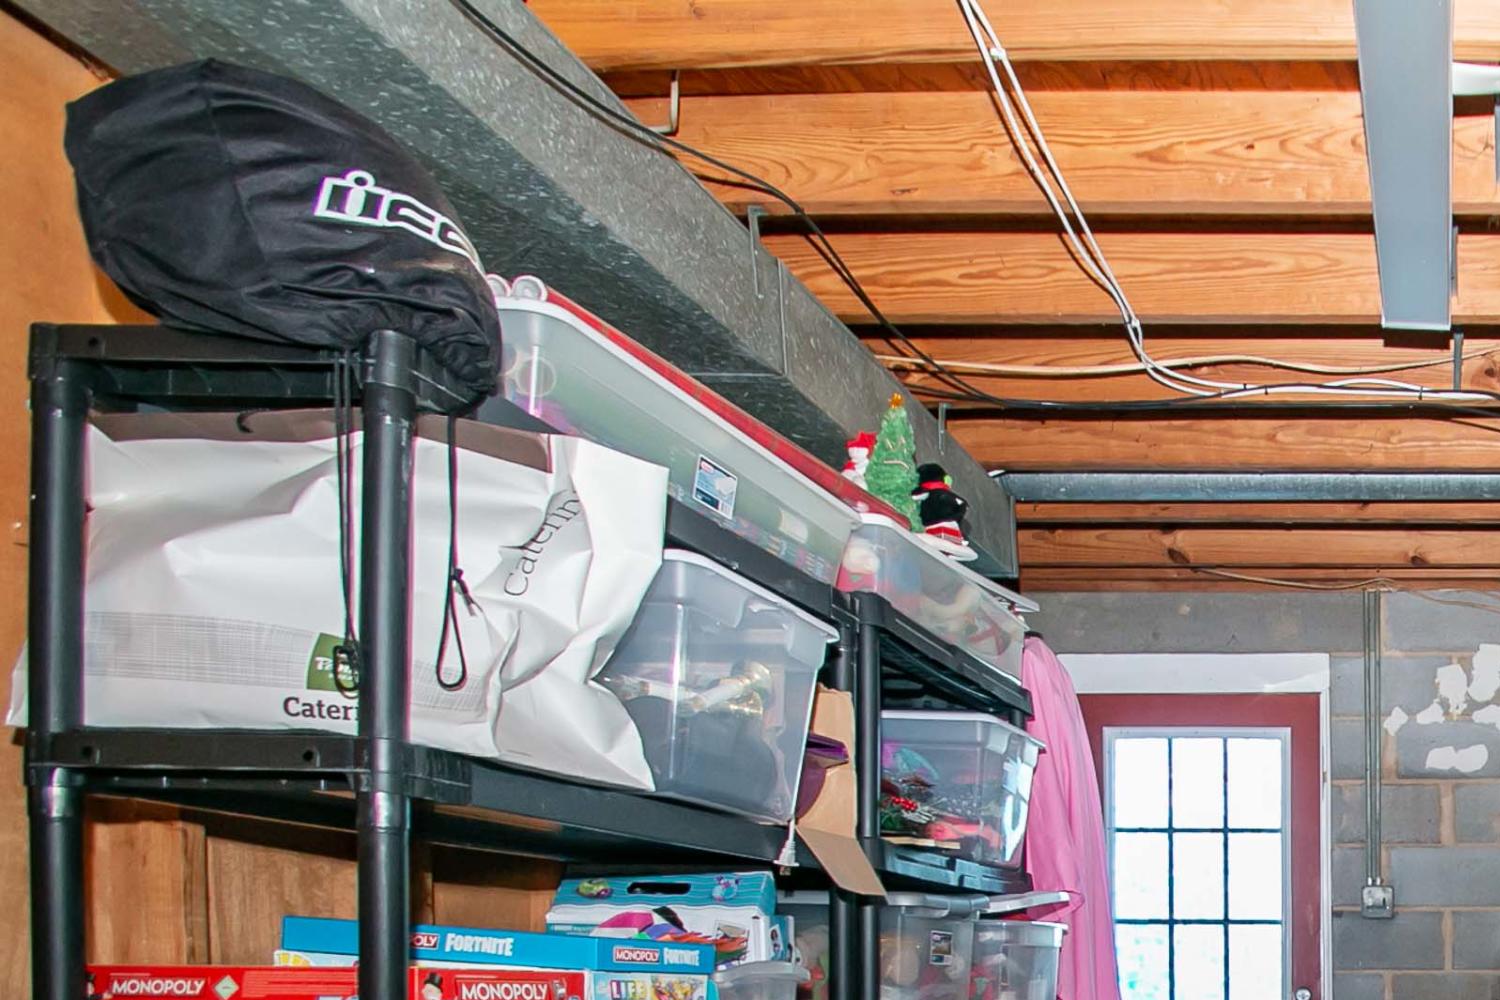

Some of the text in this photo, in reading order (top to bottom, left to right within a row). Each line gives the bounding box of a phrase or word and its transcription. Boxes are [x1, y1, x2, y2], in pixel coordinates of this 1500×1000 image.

[445, 933, 514, 957] FORTNITE
[615, 948, 660, 962] MONOPOLY
[112, 979, 206, 996] MONOPOLY
[610, 980, 648, 1000] LIFE
